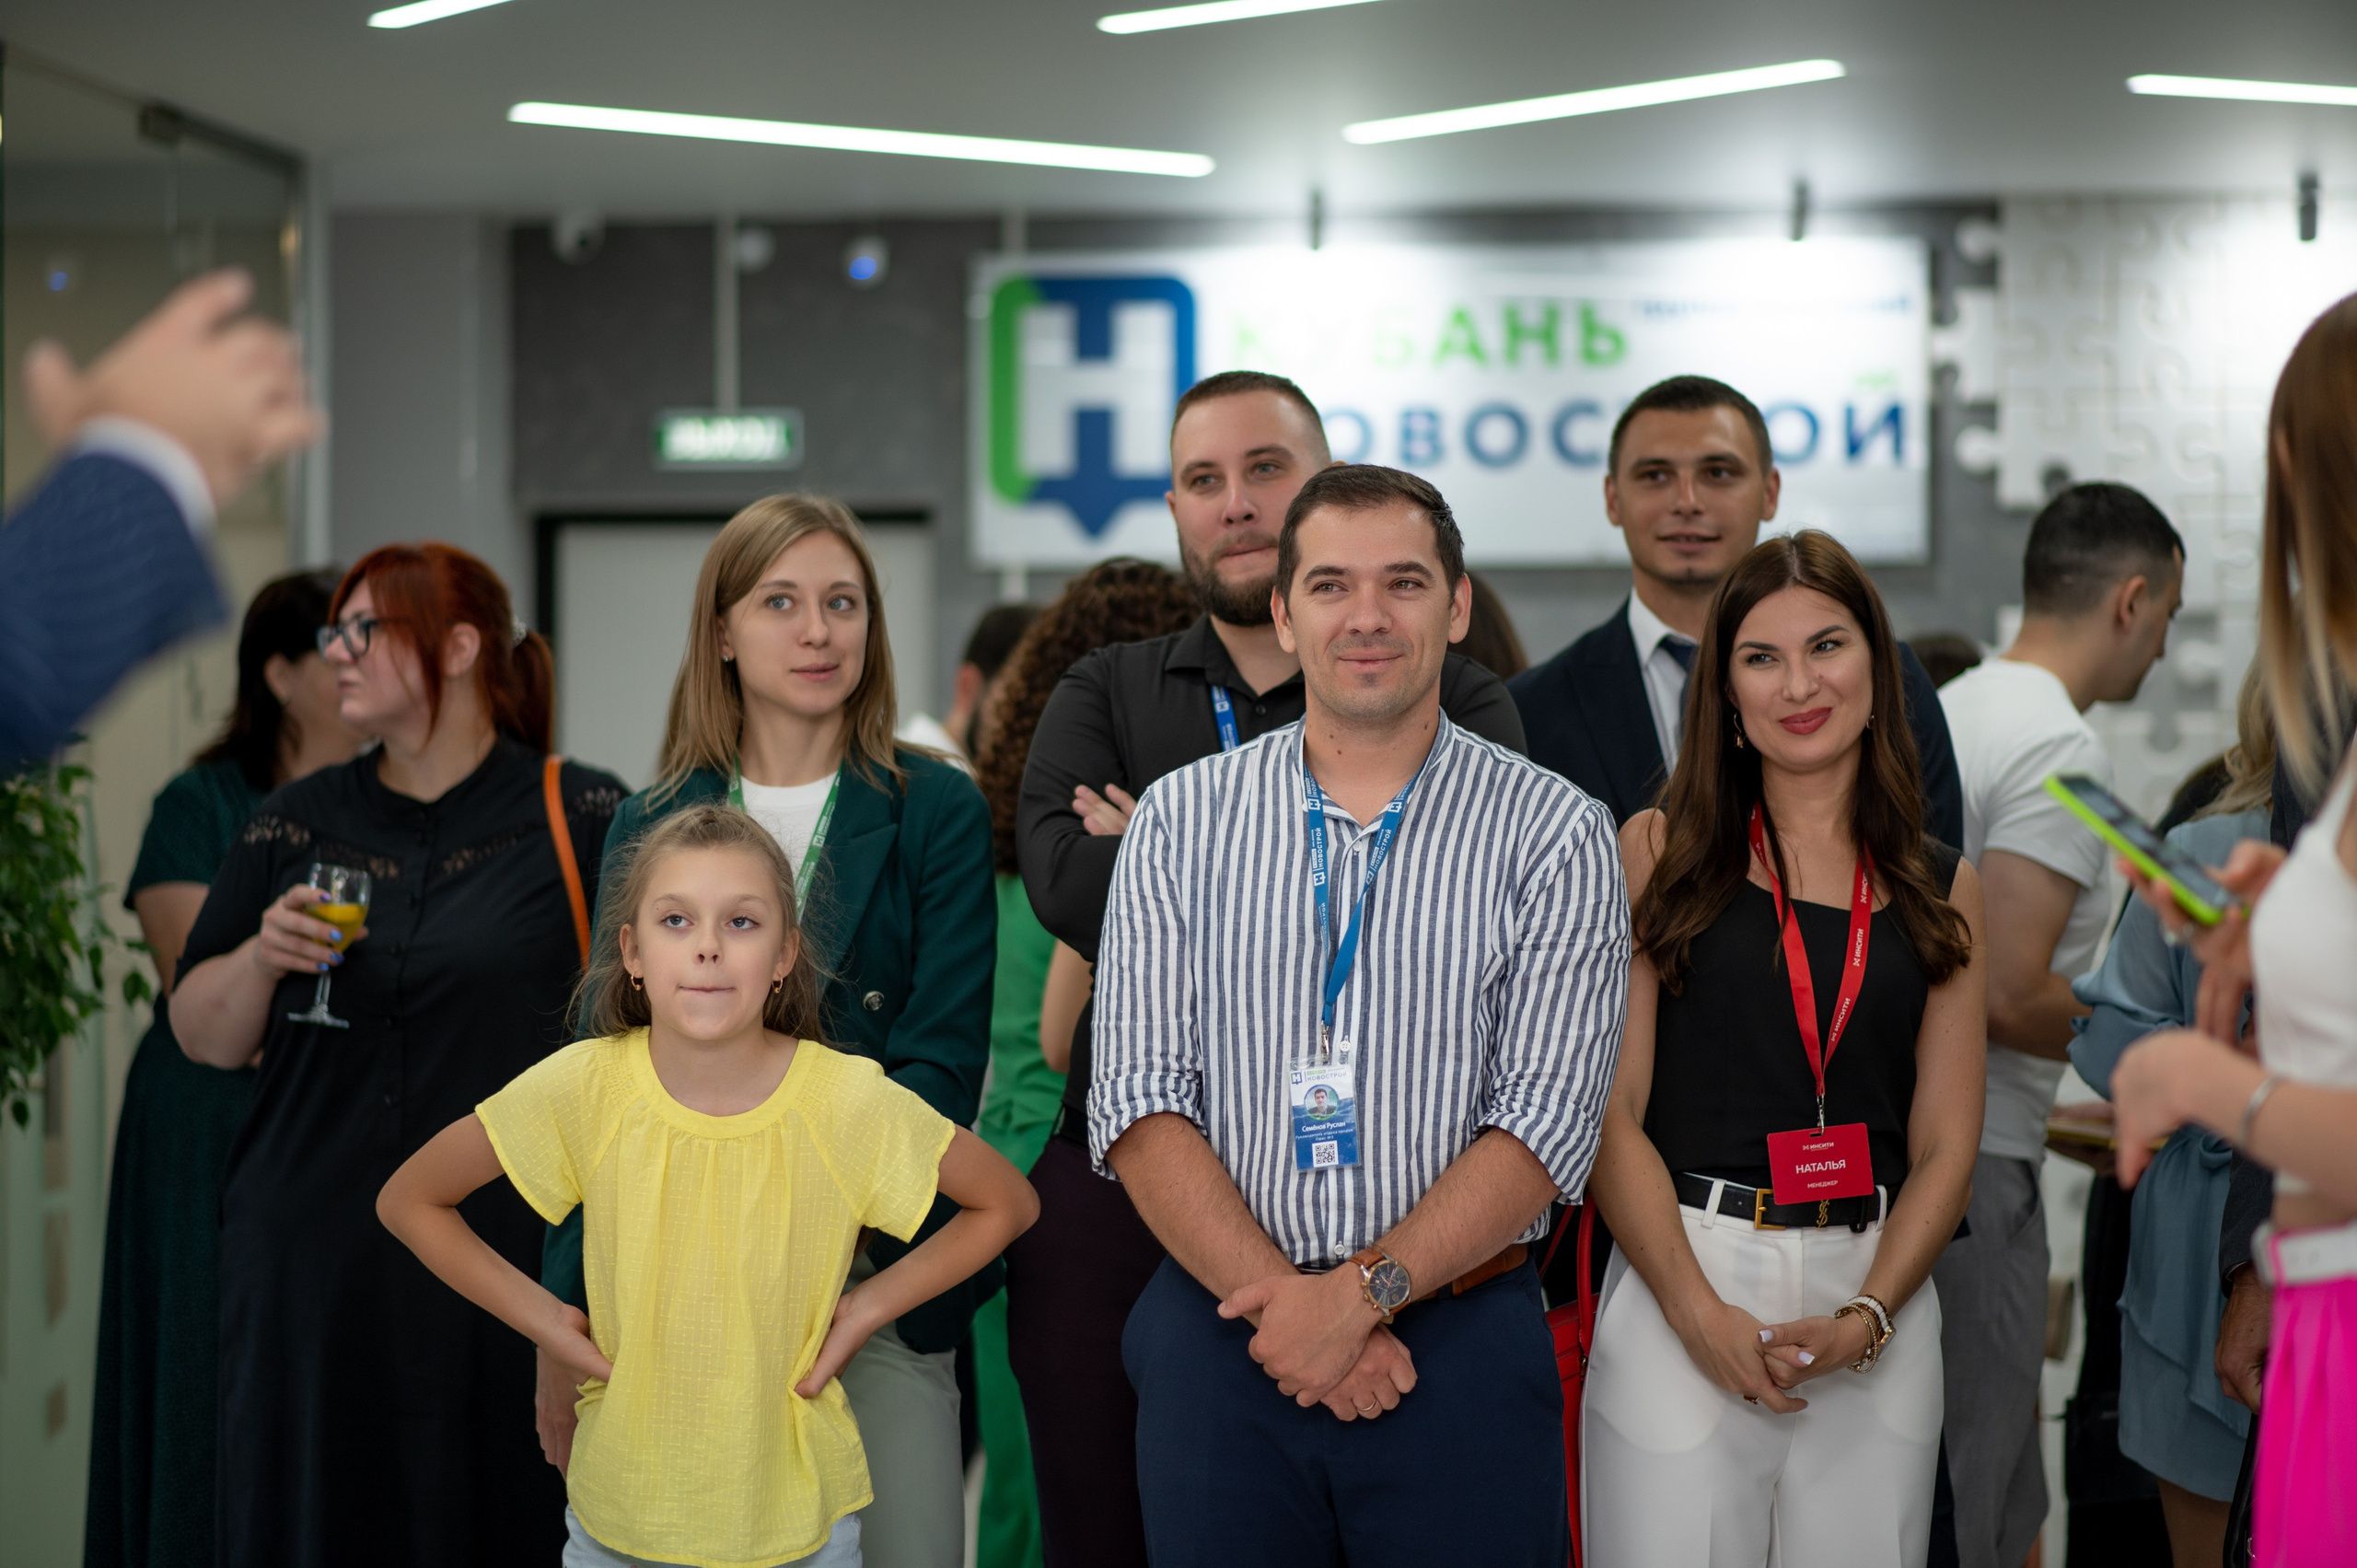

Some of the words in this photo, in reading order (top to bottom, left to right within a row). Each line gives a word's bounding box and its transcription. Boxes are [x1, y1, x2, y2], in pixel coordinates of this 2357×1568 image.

[1228, 293, 1628, 370] КБАНЬ
[1322, 376, 1904, 471] ОВОСОЙ
[1315, 828, 1323, 868] НОВОСТРОЙ
[1374, 829, 1392, 870] НОВОСТРОЙ
[1854, 928, 1864, 958] ИНСИТИ
[1834, 997, 1851, 1031] ИНСИТИ
[1307, 1072, 1347, 1082] НОВОСТРОЙ
[1327, 1121, 1345, 1130] Руслан
[1810, 1142, 1834, 1150] ИНСИТИ
[1795, 1159, 1846, 1174] НАТАЛЬЯ
[1807, 1179, 1839, 1189] МЕНЕДЖЕР
